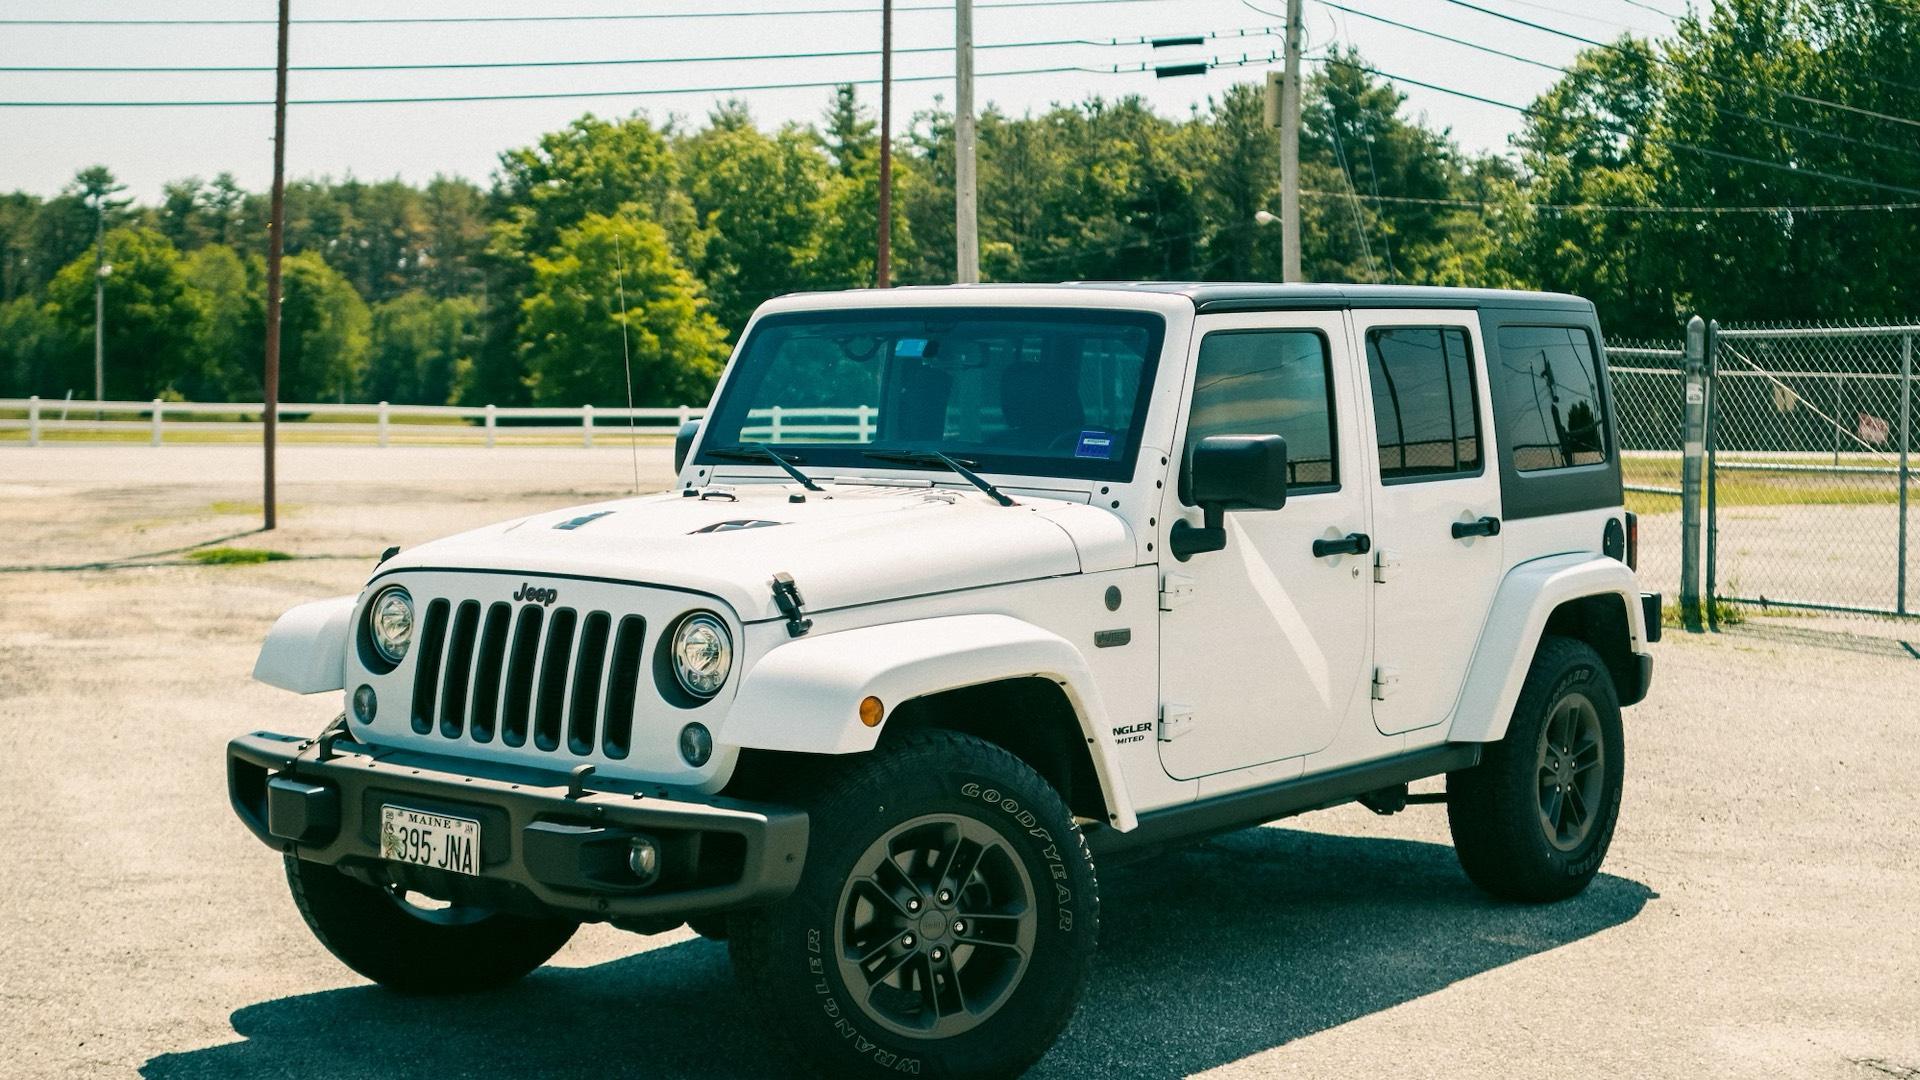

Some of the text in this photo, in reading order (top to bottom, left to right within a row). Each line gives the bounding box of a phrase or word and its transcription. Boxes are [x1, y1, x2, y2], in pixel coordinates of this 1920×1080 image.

[513, 582, 558, 607] Jeep
[408, 813, 451, 829] MAINE
[961, 782, 1073, 932] GOODYEAR
[807, 928, 921, 1075] WRANGLER
